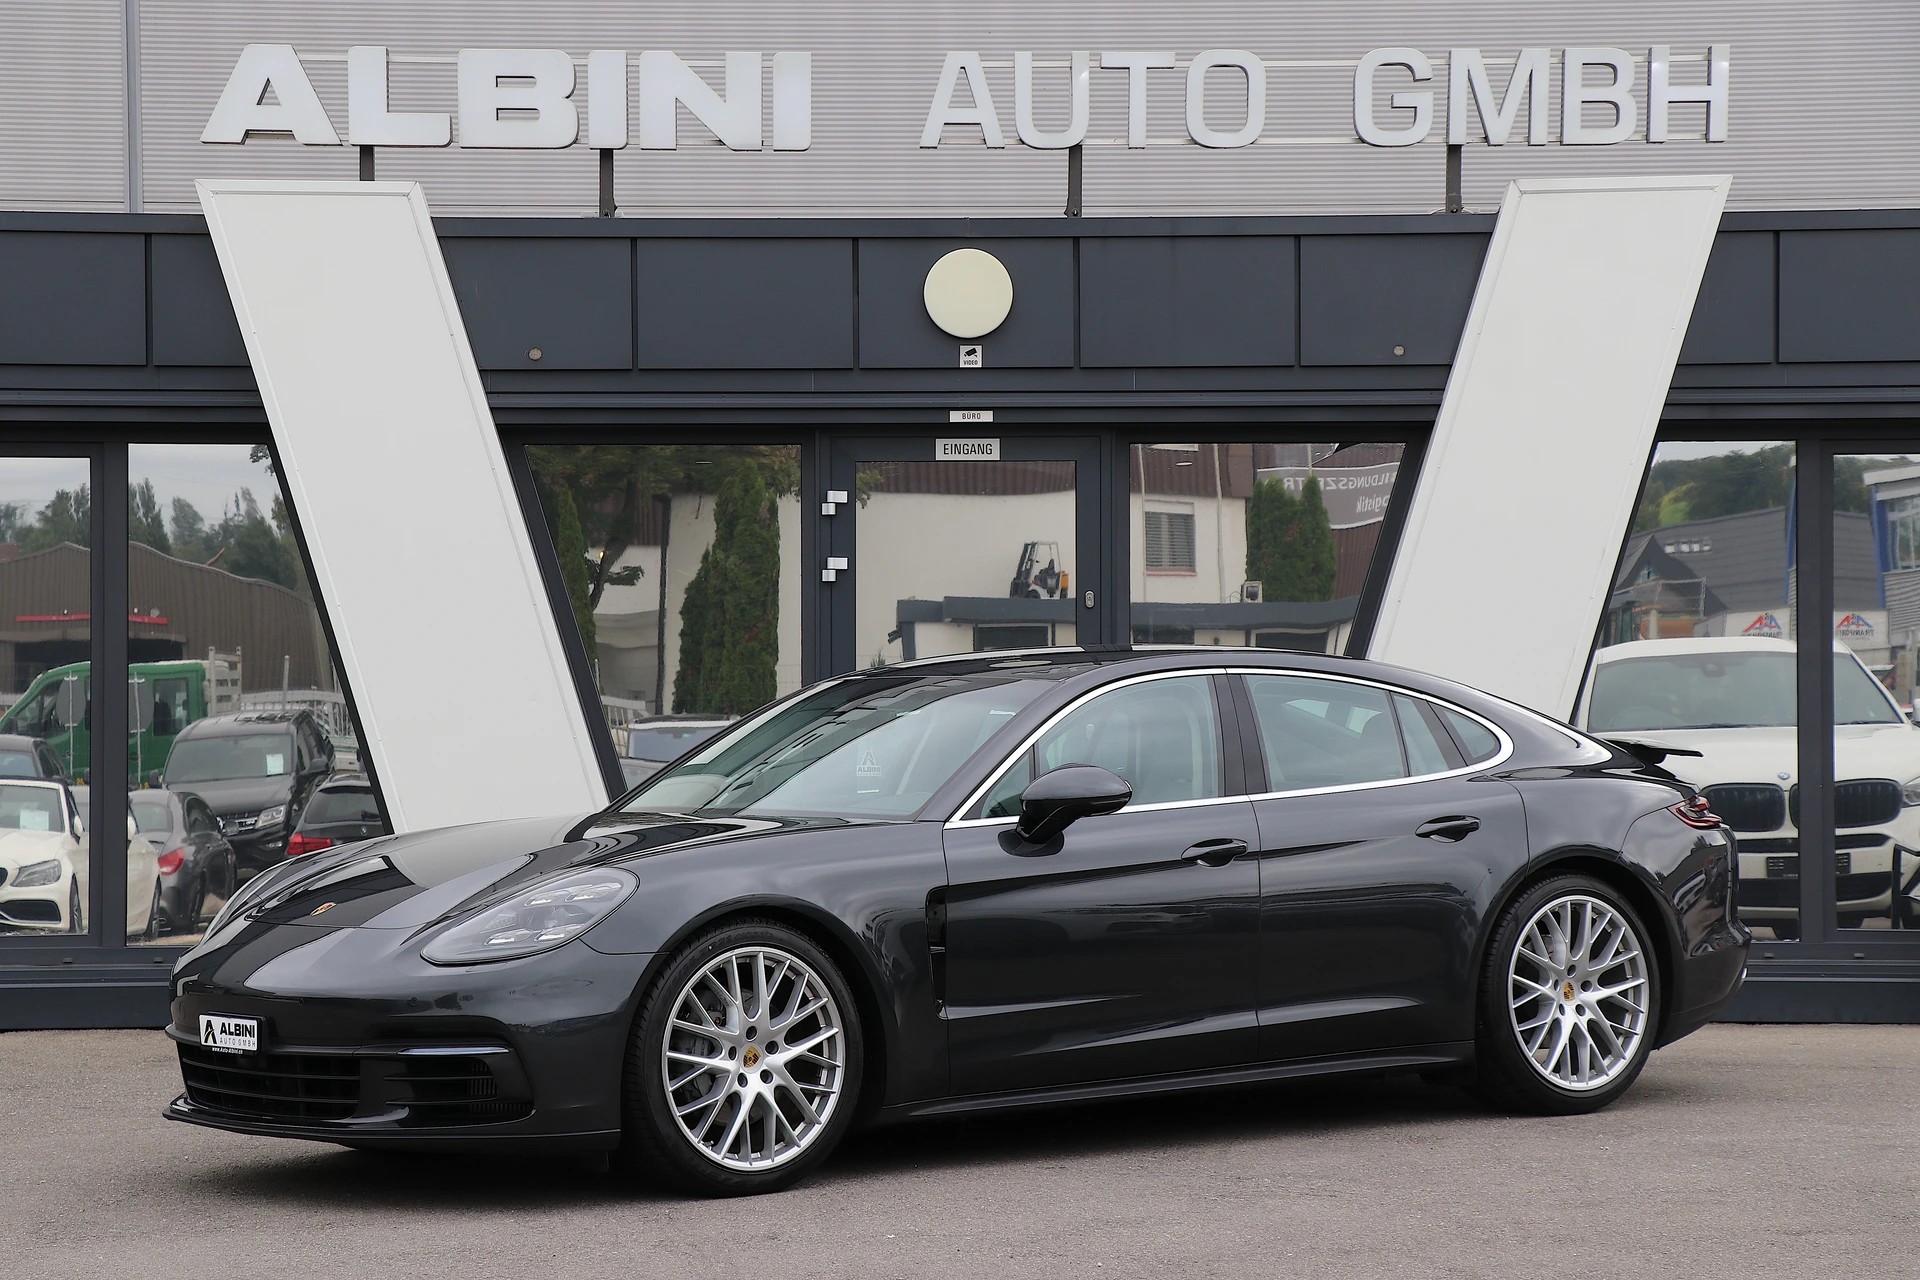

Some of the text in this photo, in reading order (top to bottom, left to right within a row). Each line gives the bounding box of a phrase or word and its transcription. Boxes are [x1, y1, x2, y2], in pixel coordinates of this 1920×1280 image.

[200, 43, 1731, 152] ALBINI AUTO GMBH
[961, 412, 982, 420] BÜRO
[943, 443, 993, 455] EINGANG
[220, 1022, 255, 1038] ALBINI
[220, 1038, 256, 1048] AUTO GMBH
